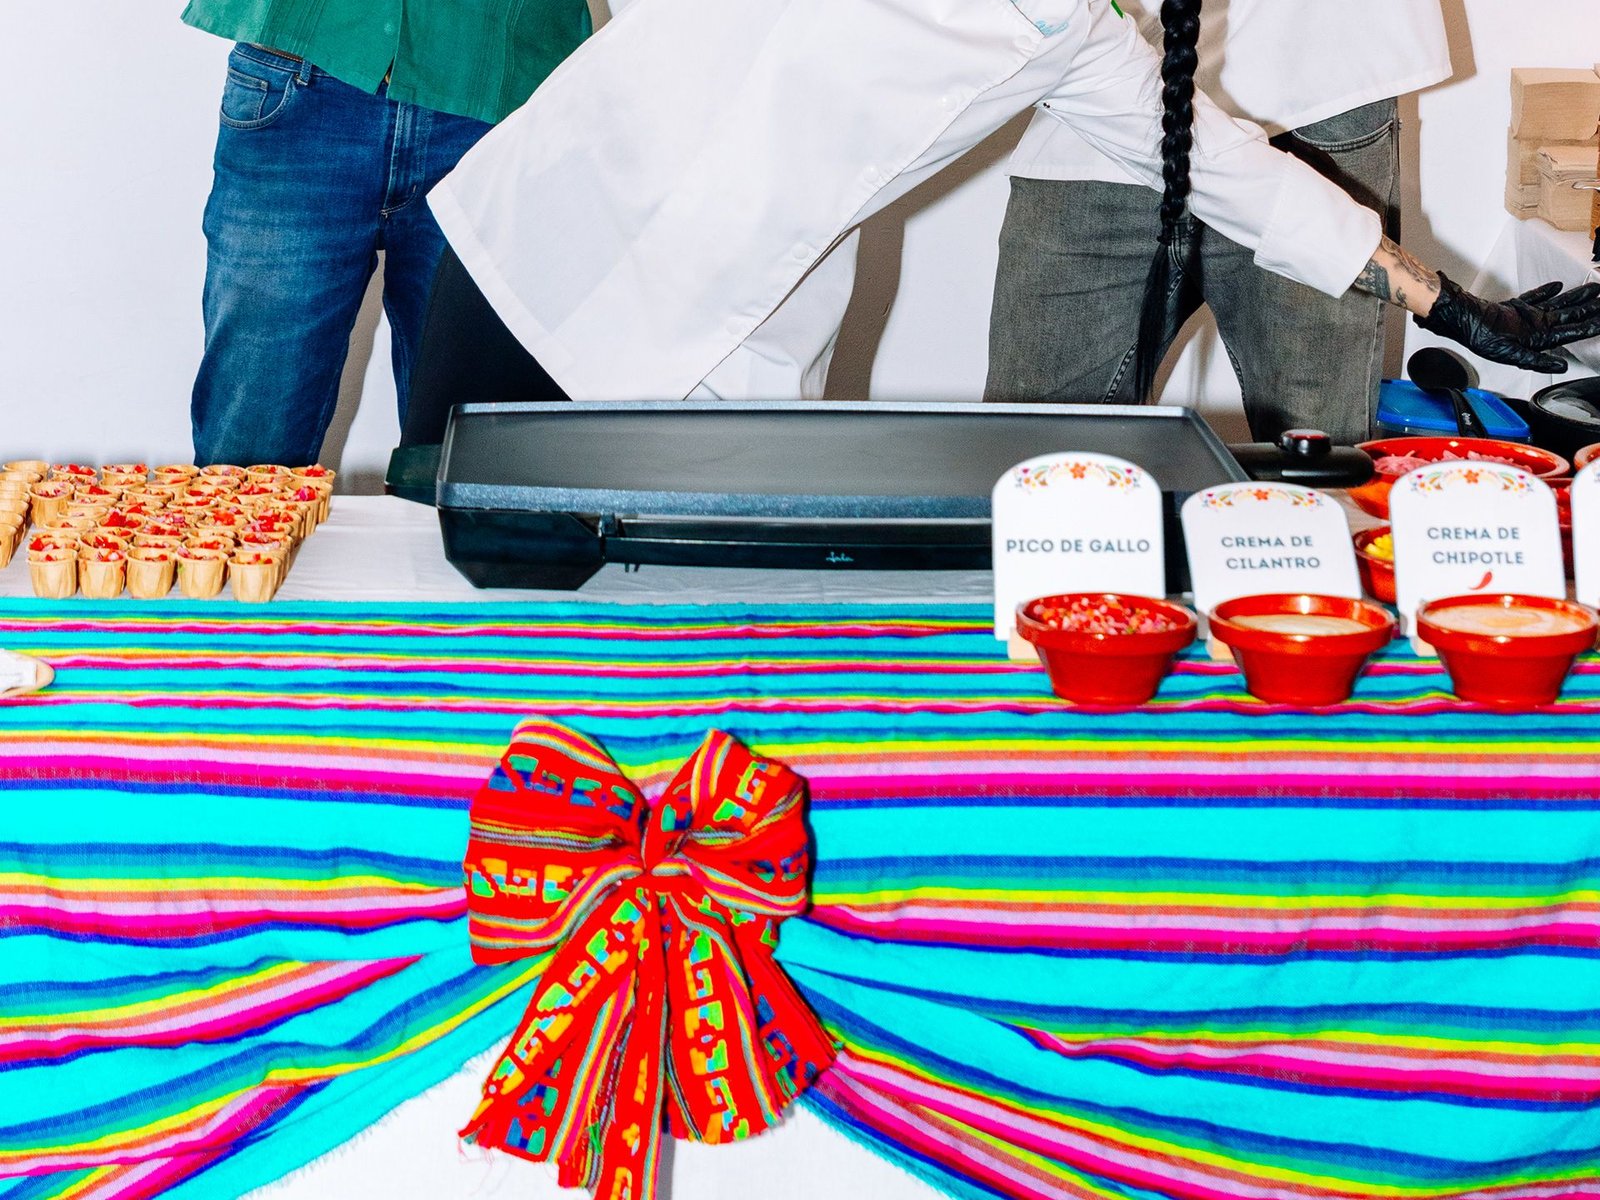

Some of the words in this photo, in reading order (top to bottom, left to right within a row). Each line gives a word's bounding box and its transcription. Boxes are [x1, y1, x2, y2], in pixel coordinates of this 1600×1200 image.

[1426, 526, 1493, 541] CREMA
[1498, 526, 1521, 541] DE
[1005, 538, 1055, 554] PICO
[1060, 538, 1083, 554] DE
[1088, 538, 1151, 554] GALLO
[1220, 535, 1286, 549] CREMA
[1290, 534, 1314, 548] DE
[1225, 556, 1321, 570] CILANTRO
[1431, 550, 1525, 565] CHIPOTLE
